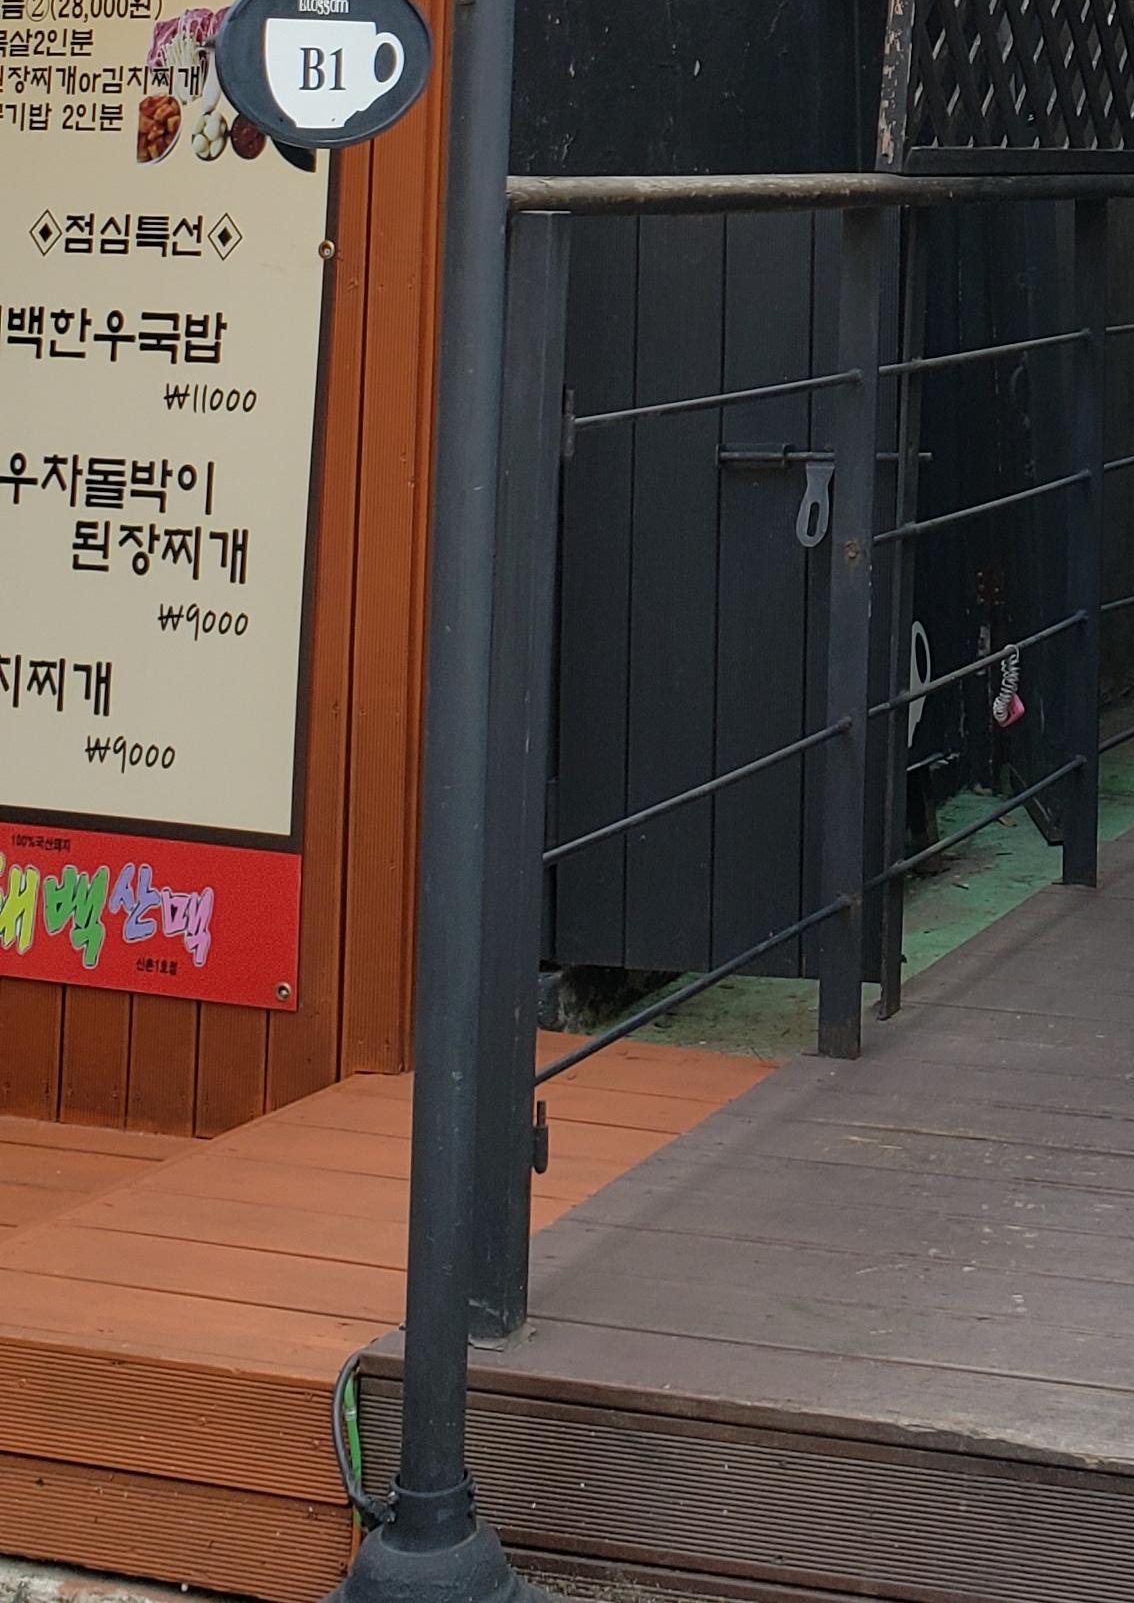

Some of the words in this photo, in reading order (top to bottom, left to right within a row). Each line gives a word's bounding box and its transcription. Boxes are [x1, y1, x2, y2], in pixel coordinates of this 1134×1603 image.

[0, 65, 201, 95] 장찌개or김치찌개
[299, 47, 347, 91] B1
[0, 102, 52, 132] 기밥
[62, 102, 124, 132] 2인분
[64, 213, 204, 258] 점심특선
[0, 305, 228, 365] 백한우국밥
[72, 520, 250, 585] 된장찌개
